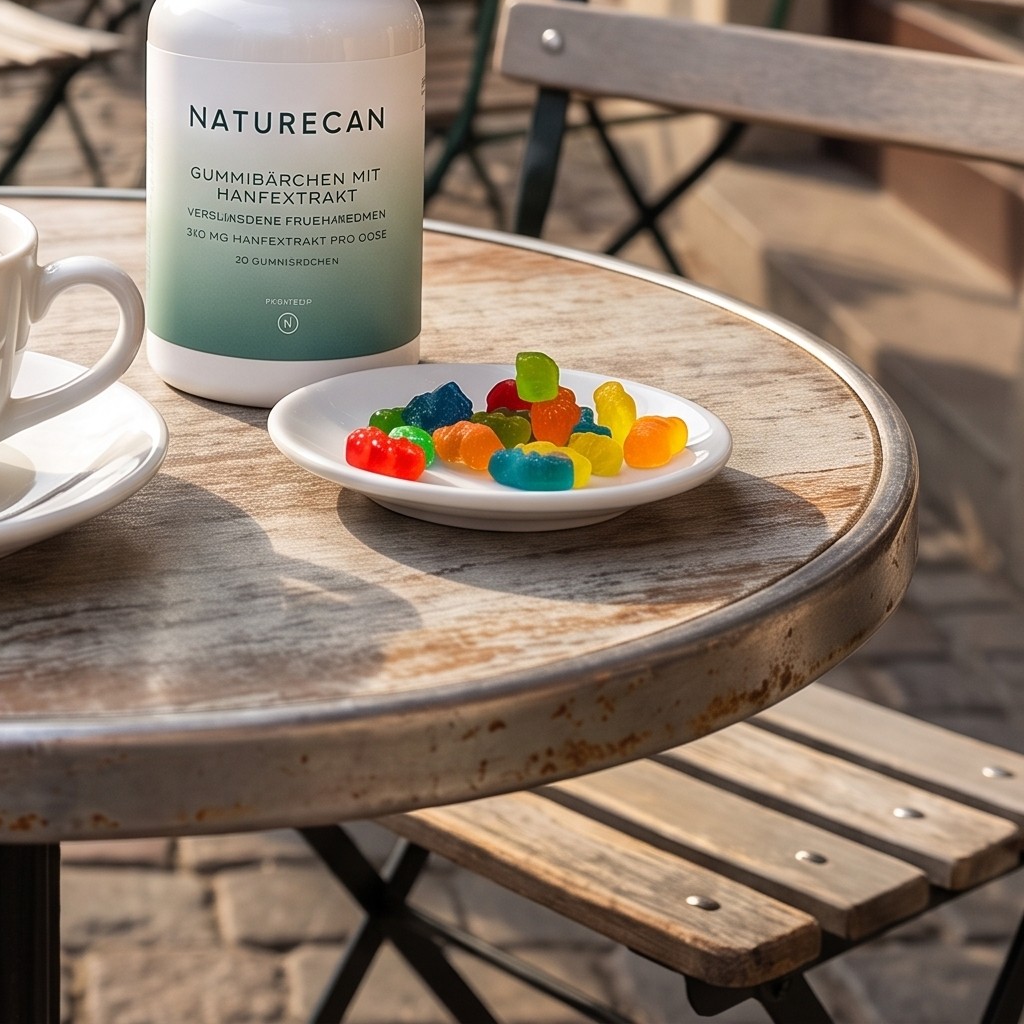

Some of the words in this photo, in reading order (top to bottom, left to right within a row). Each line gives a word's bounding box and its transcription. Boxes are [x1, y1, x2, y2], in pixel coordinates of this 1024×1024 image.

[189, 104, 384, 135] NATURECAN
[190, 166, 345, 187] GUMMIBÄRCHEN
[352, 167, 381, 184] MIT
[217, 187, 358, 205] HANFEXTRAKT
[209, 231, 229, 242] MG
[232, 234, 327, 246] HANFEXTRAKT
[330, 234, 355, 245] PRO
[235, 256, 249, 265] 20
